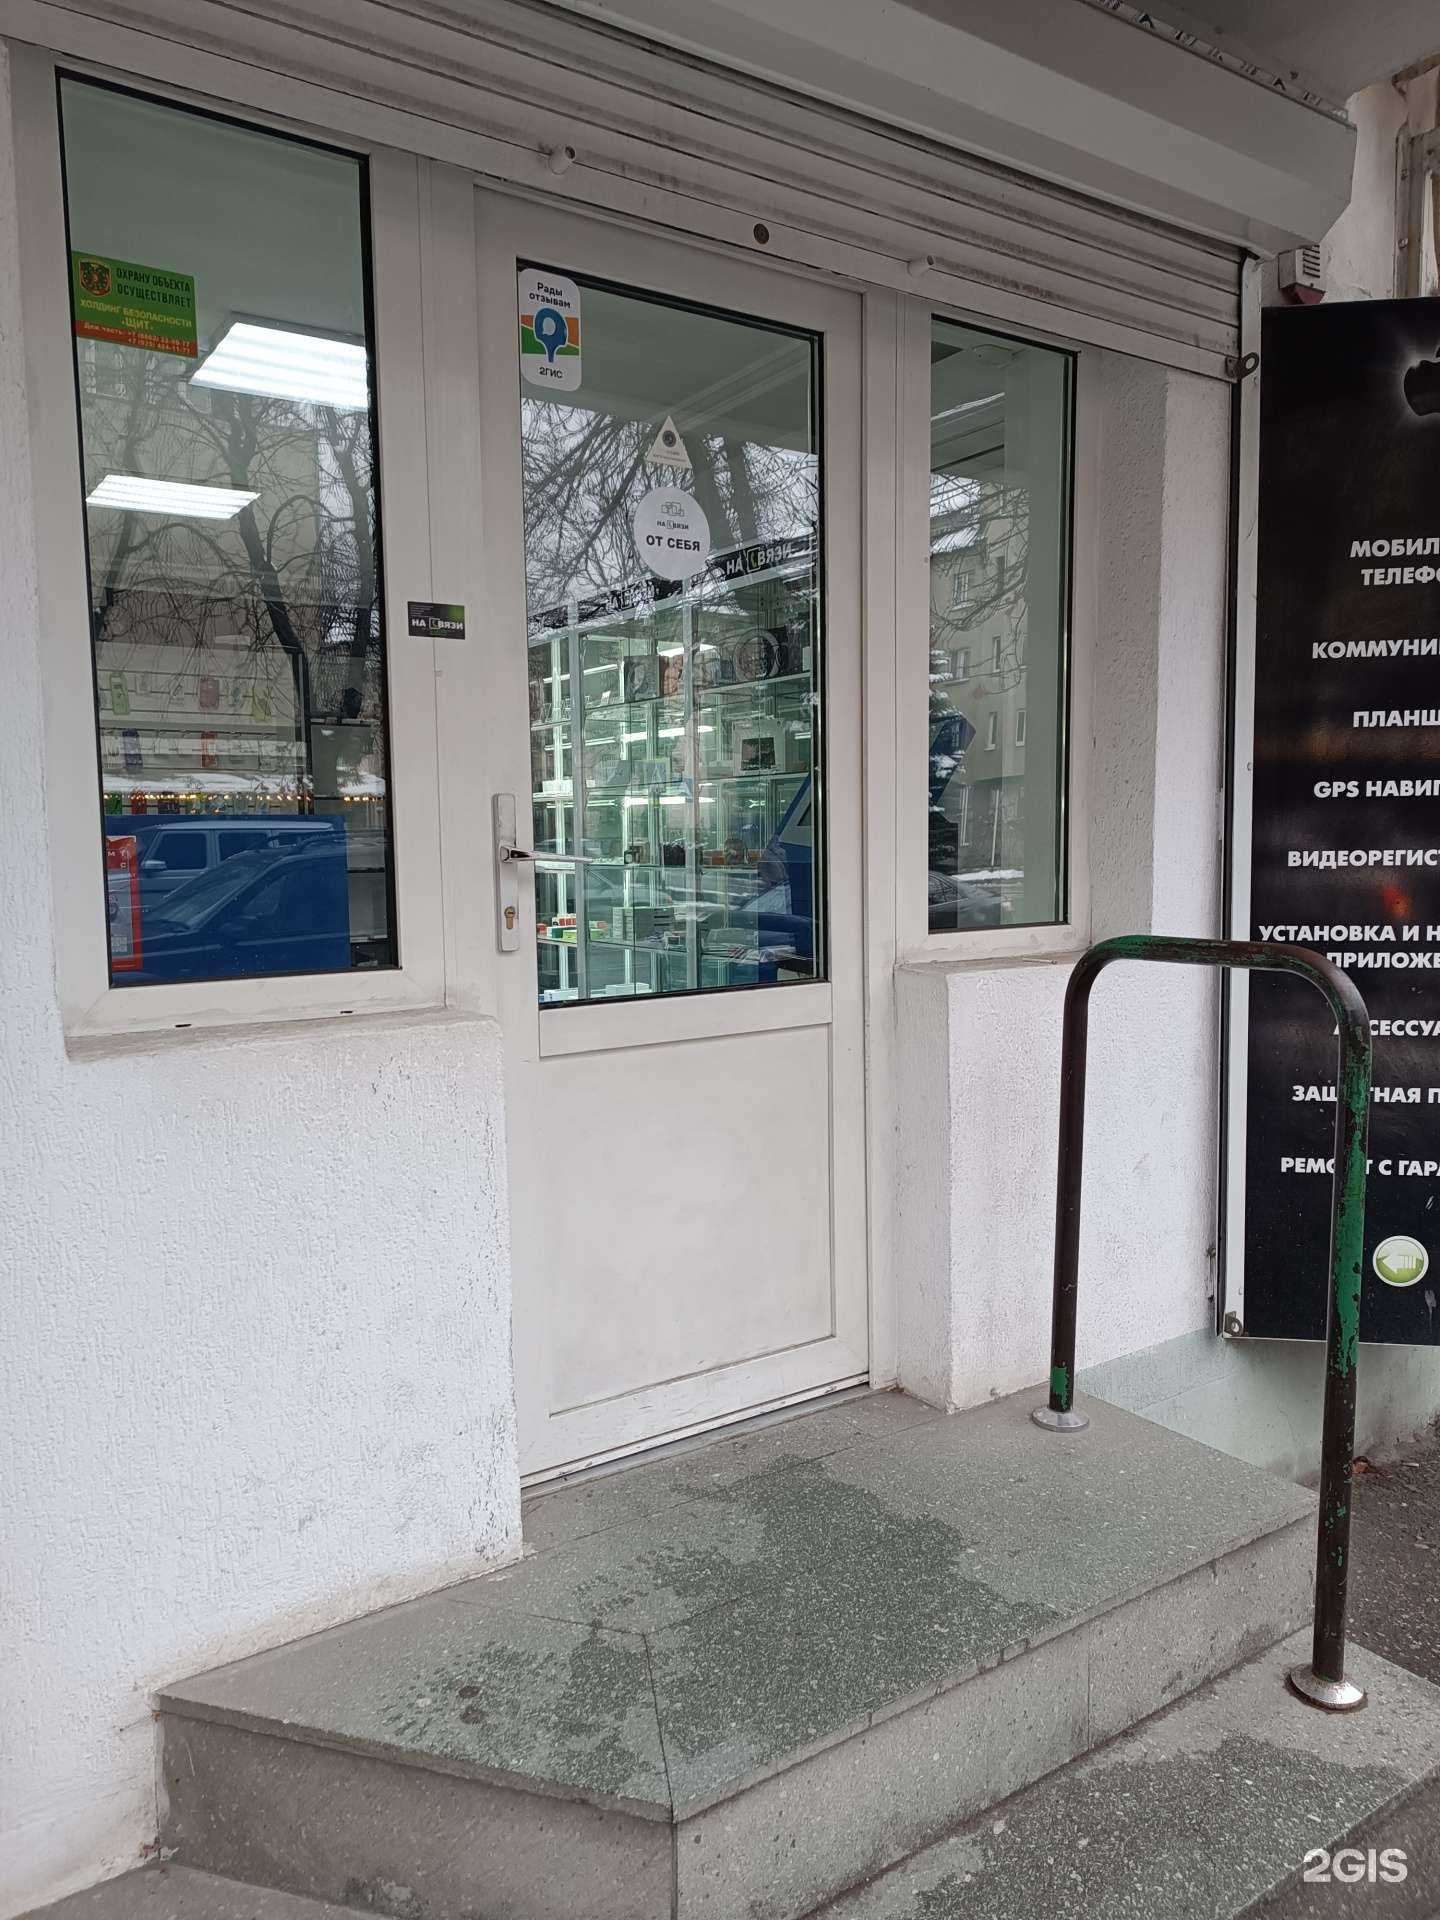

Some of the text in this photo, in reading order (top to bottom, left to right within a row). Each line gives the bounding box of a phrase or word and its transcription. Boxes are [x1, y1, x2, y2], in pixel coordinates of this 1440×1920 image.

[116, 267, 190, 292] ОХРАНУ ОБЪЕКТА
[116, 284, 192, 308] ОСУЩЕСТВЛЯЕТ
[537, 282, 562, 297] Рады
[529, 292, 571, 309] отзывам
[80, 299, 192, 328] ХОЛДИНГ БЕЗОПАСНОСТИ
[539, 366, 563, 379] 2ГИС
[646, 535, 701, 552] ОТ СЕБЯ
[726, 556, 743, 574] НА
[1360, 566, 1440, 586] ТЕЛЕФ
[412, 618, 426, 627] НА
[1312, 638, 1440, 659] КОММУНИ
[1314, 781, 1359, 798] GPS
[1287, 849, 1440, 870] ВИДЕОРЕГИС
[1258, 924, 1396, 942] УСТАНОВКА
[1402, 925, 1419, 942] И
[1378, 1161, 1392, 1175] С
